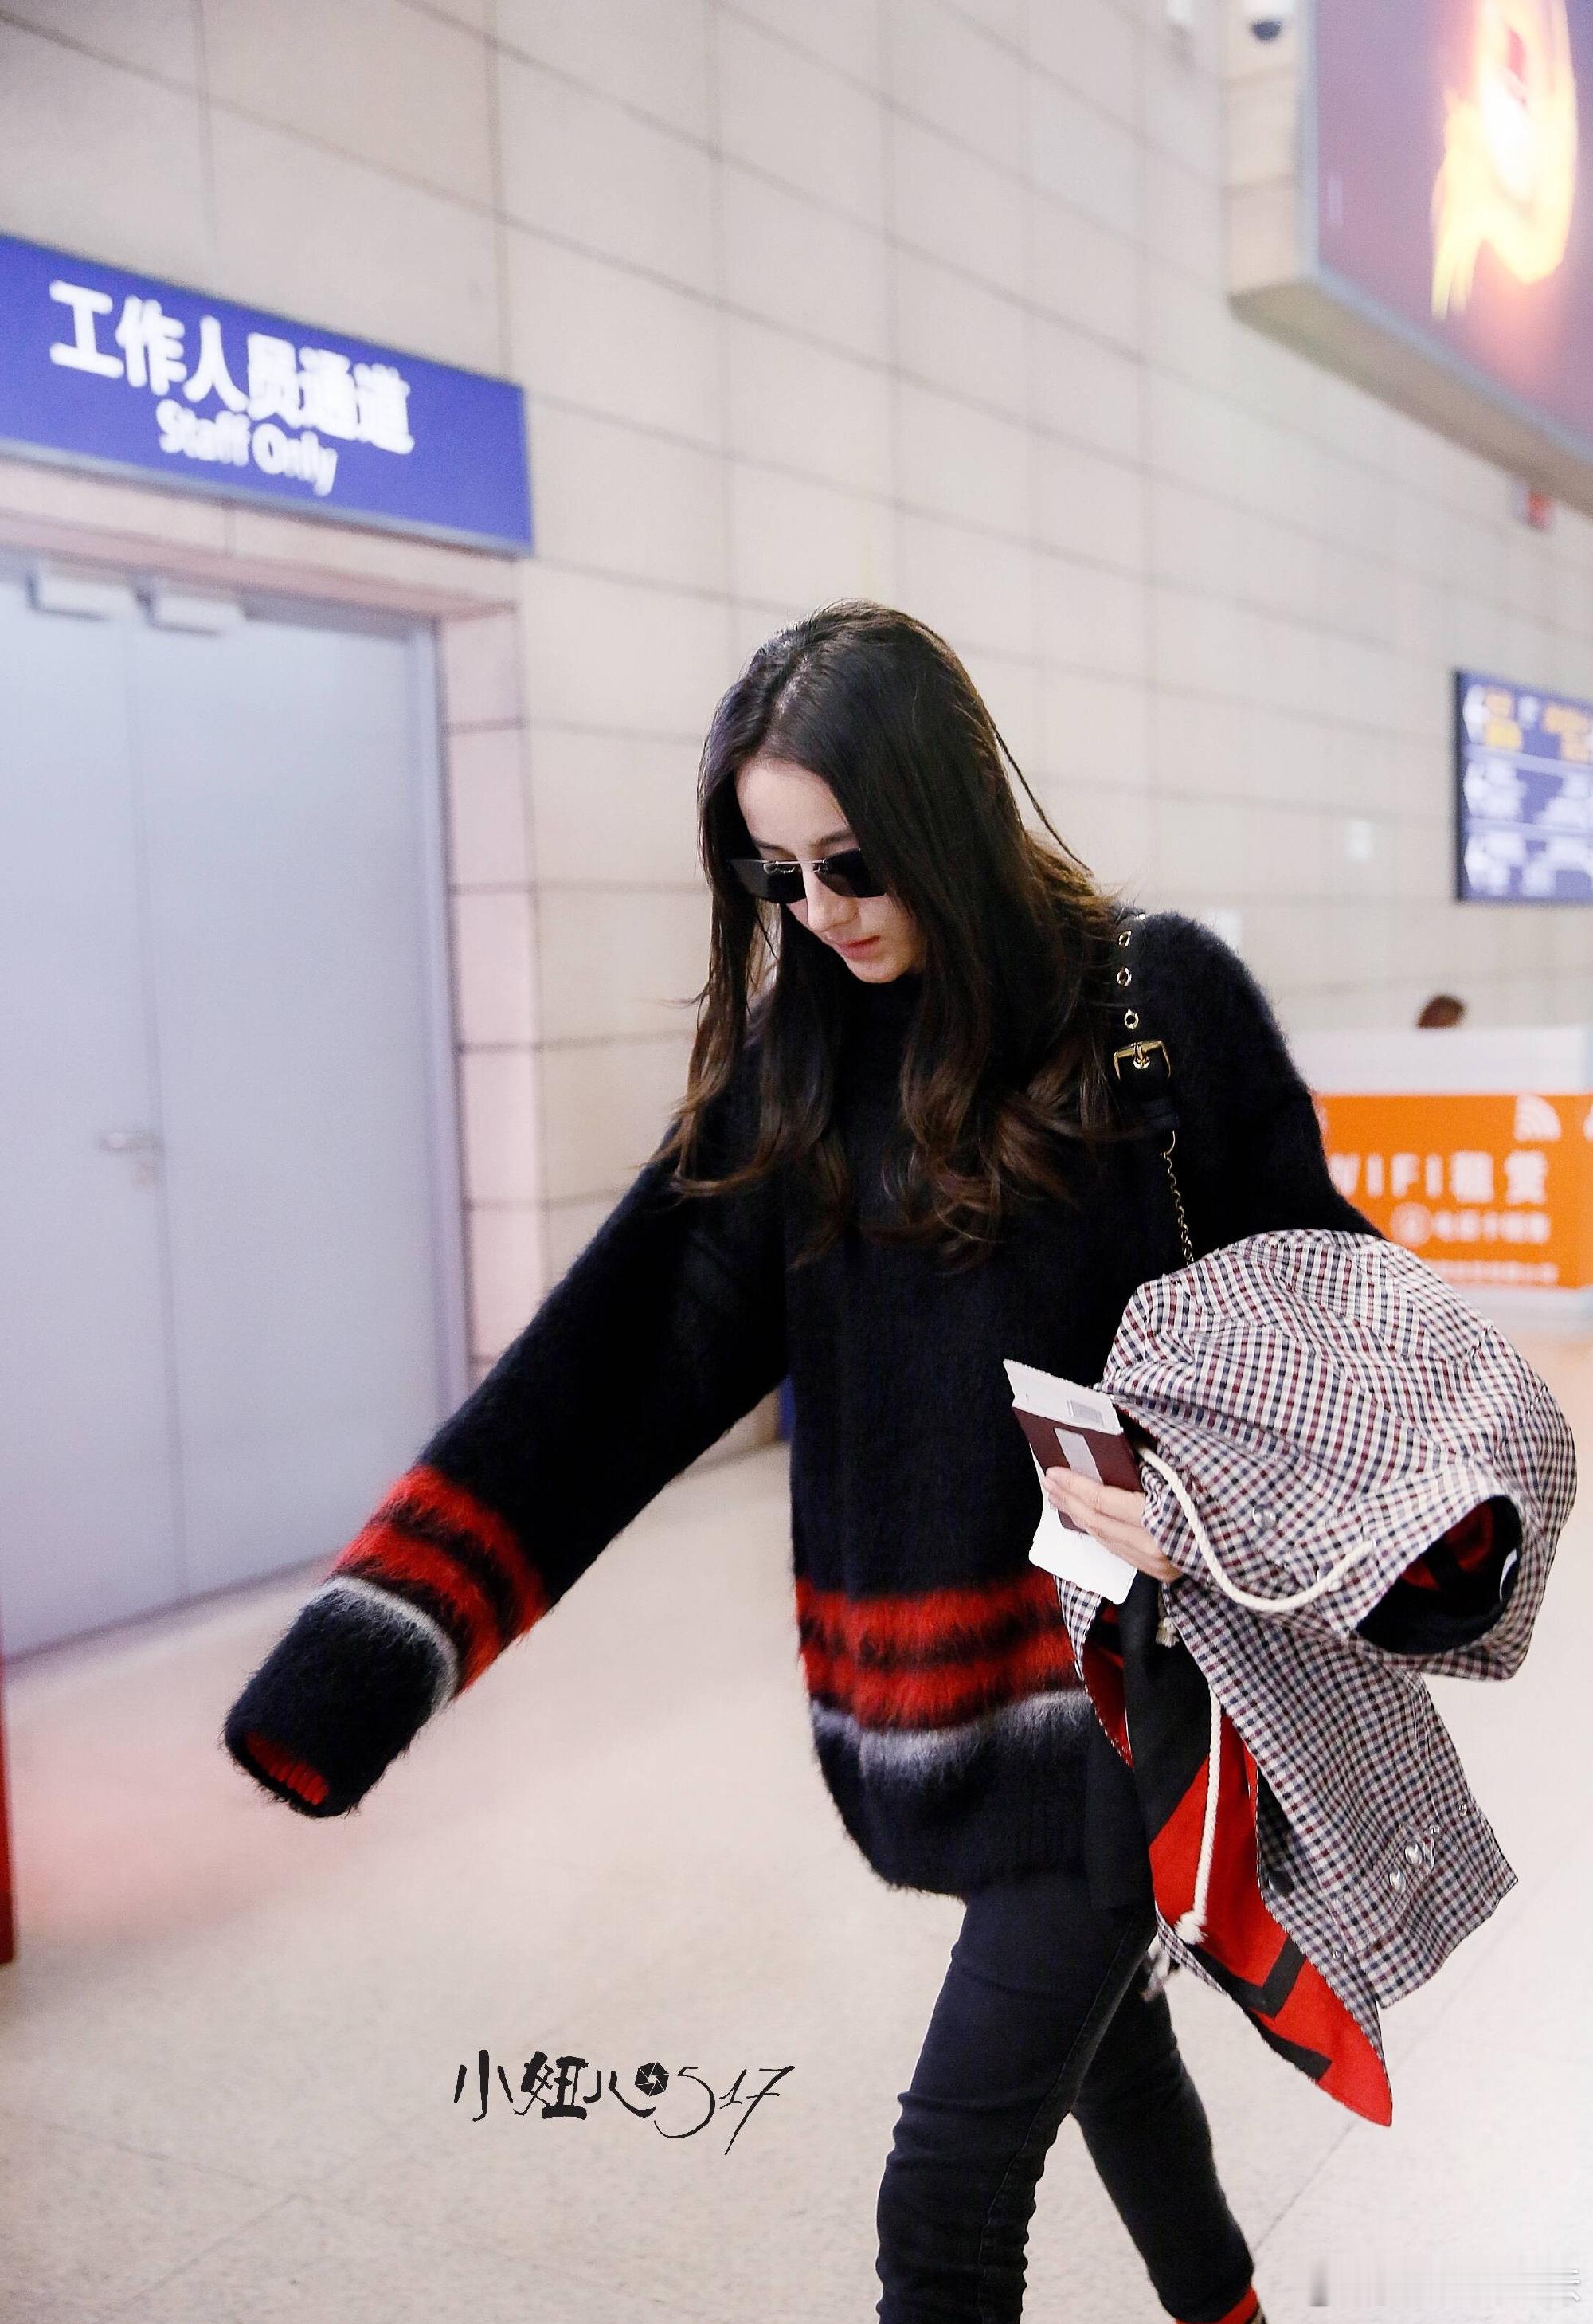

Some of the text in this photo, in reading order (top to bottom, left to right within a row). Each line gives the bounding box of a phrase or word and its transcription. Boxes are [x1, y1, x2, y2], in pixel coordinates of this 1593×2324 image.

[49, 280, 414, 454] 工作人员通道
[156, 399, 339, 496] Staff Only
